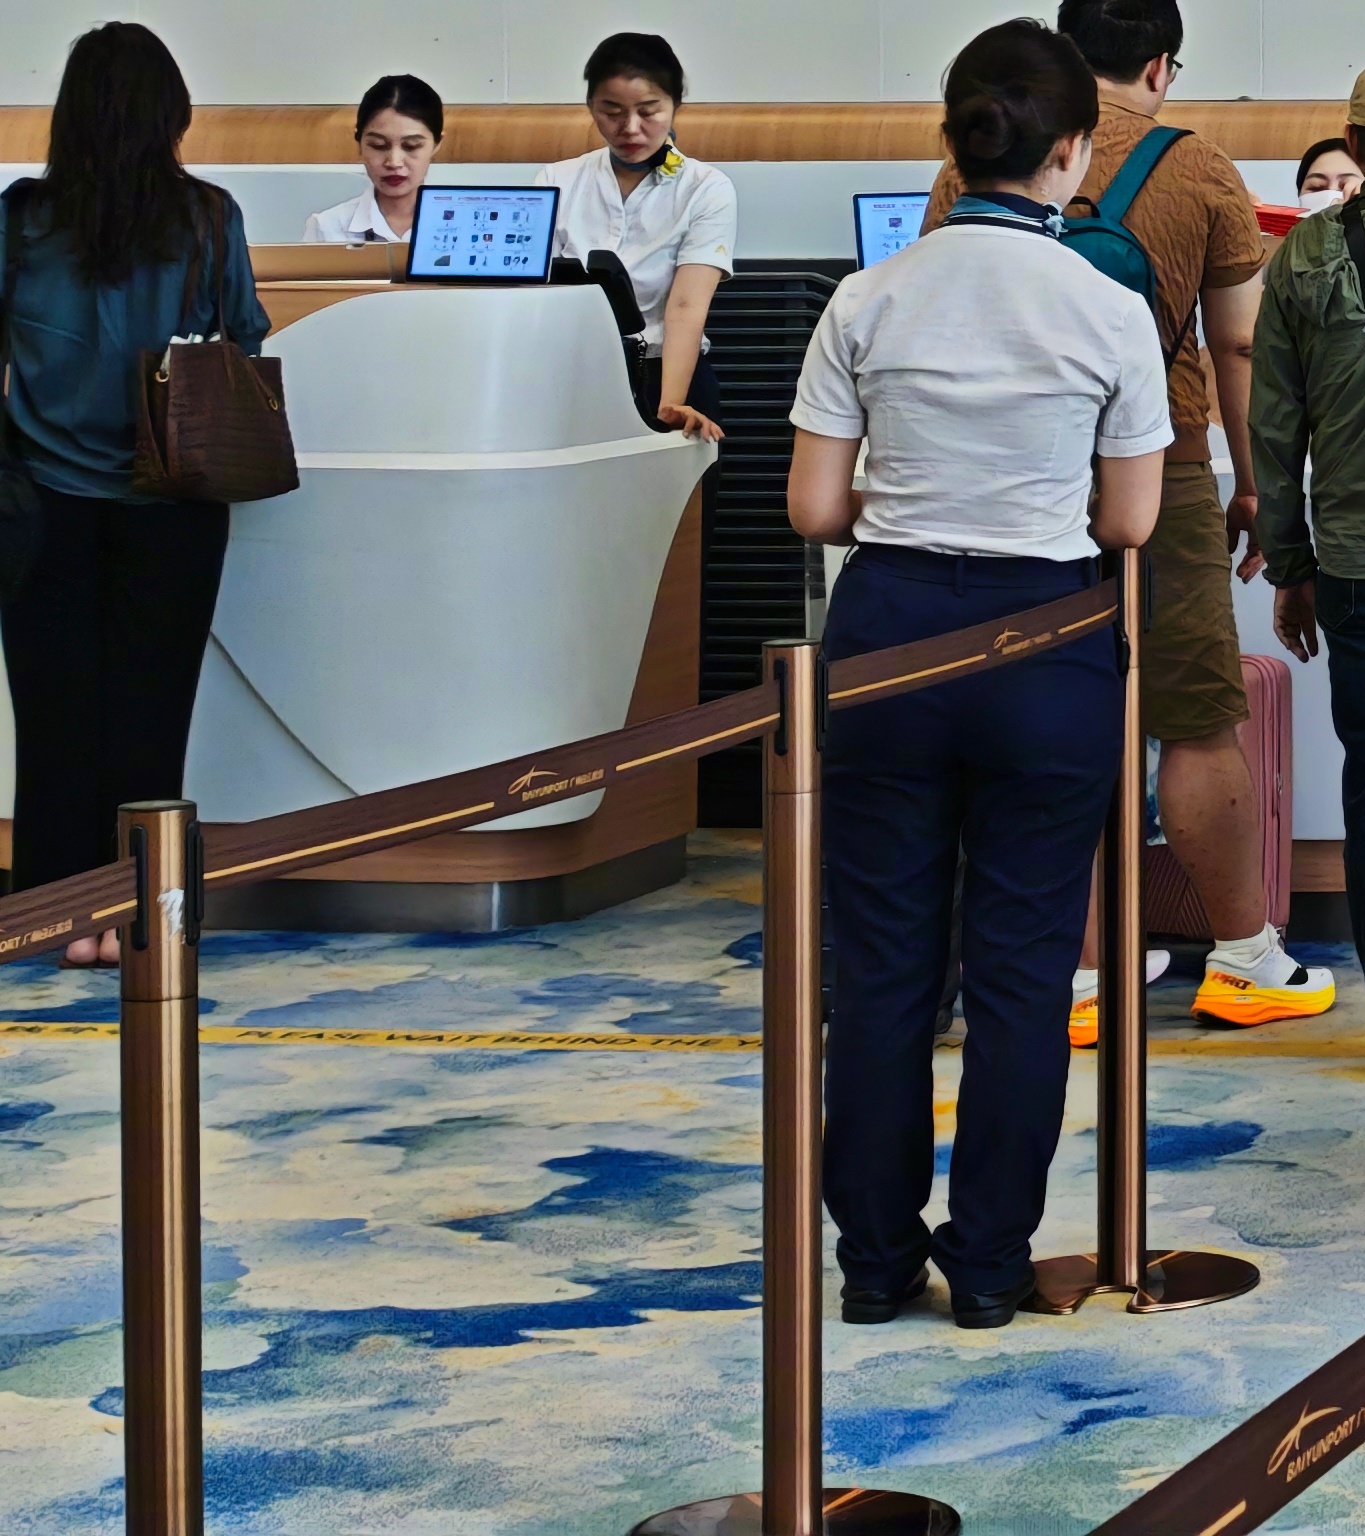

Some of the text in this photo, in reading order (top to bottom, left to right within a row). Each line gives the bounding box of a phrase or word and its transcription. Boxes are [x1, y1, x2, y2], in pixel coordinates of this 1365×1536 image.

[385, 1033, 488, 1043] WAIT
[492, 1036, 637, 1046] BEHIND
[650, 1038, 722, 1047] THE
